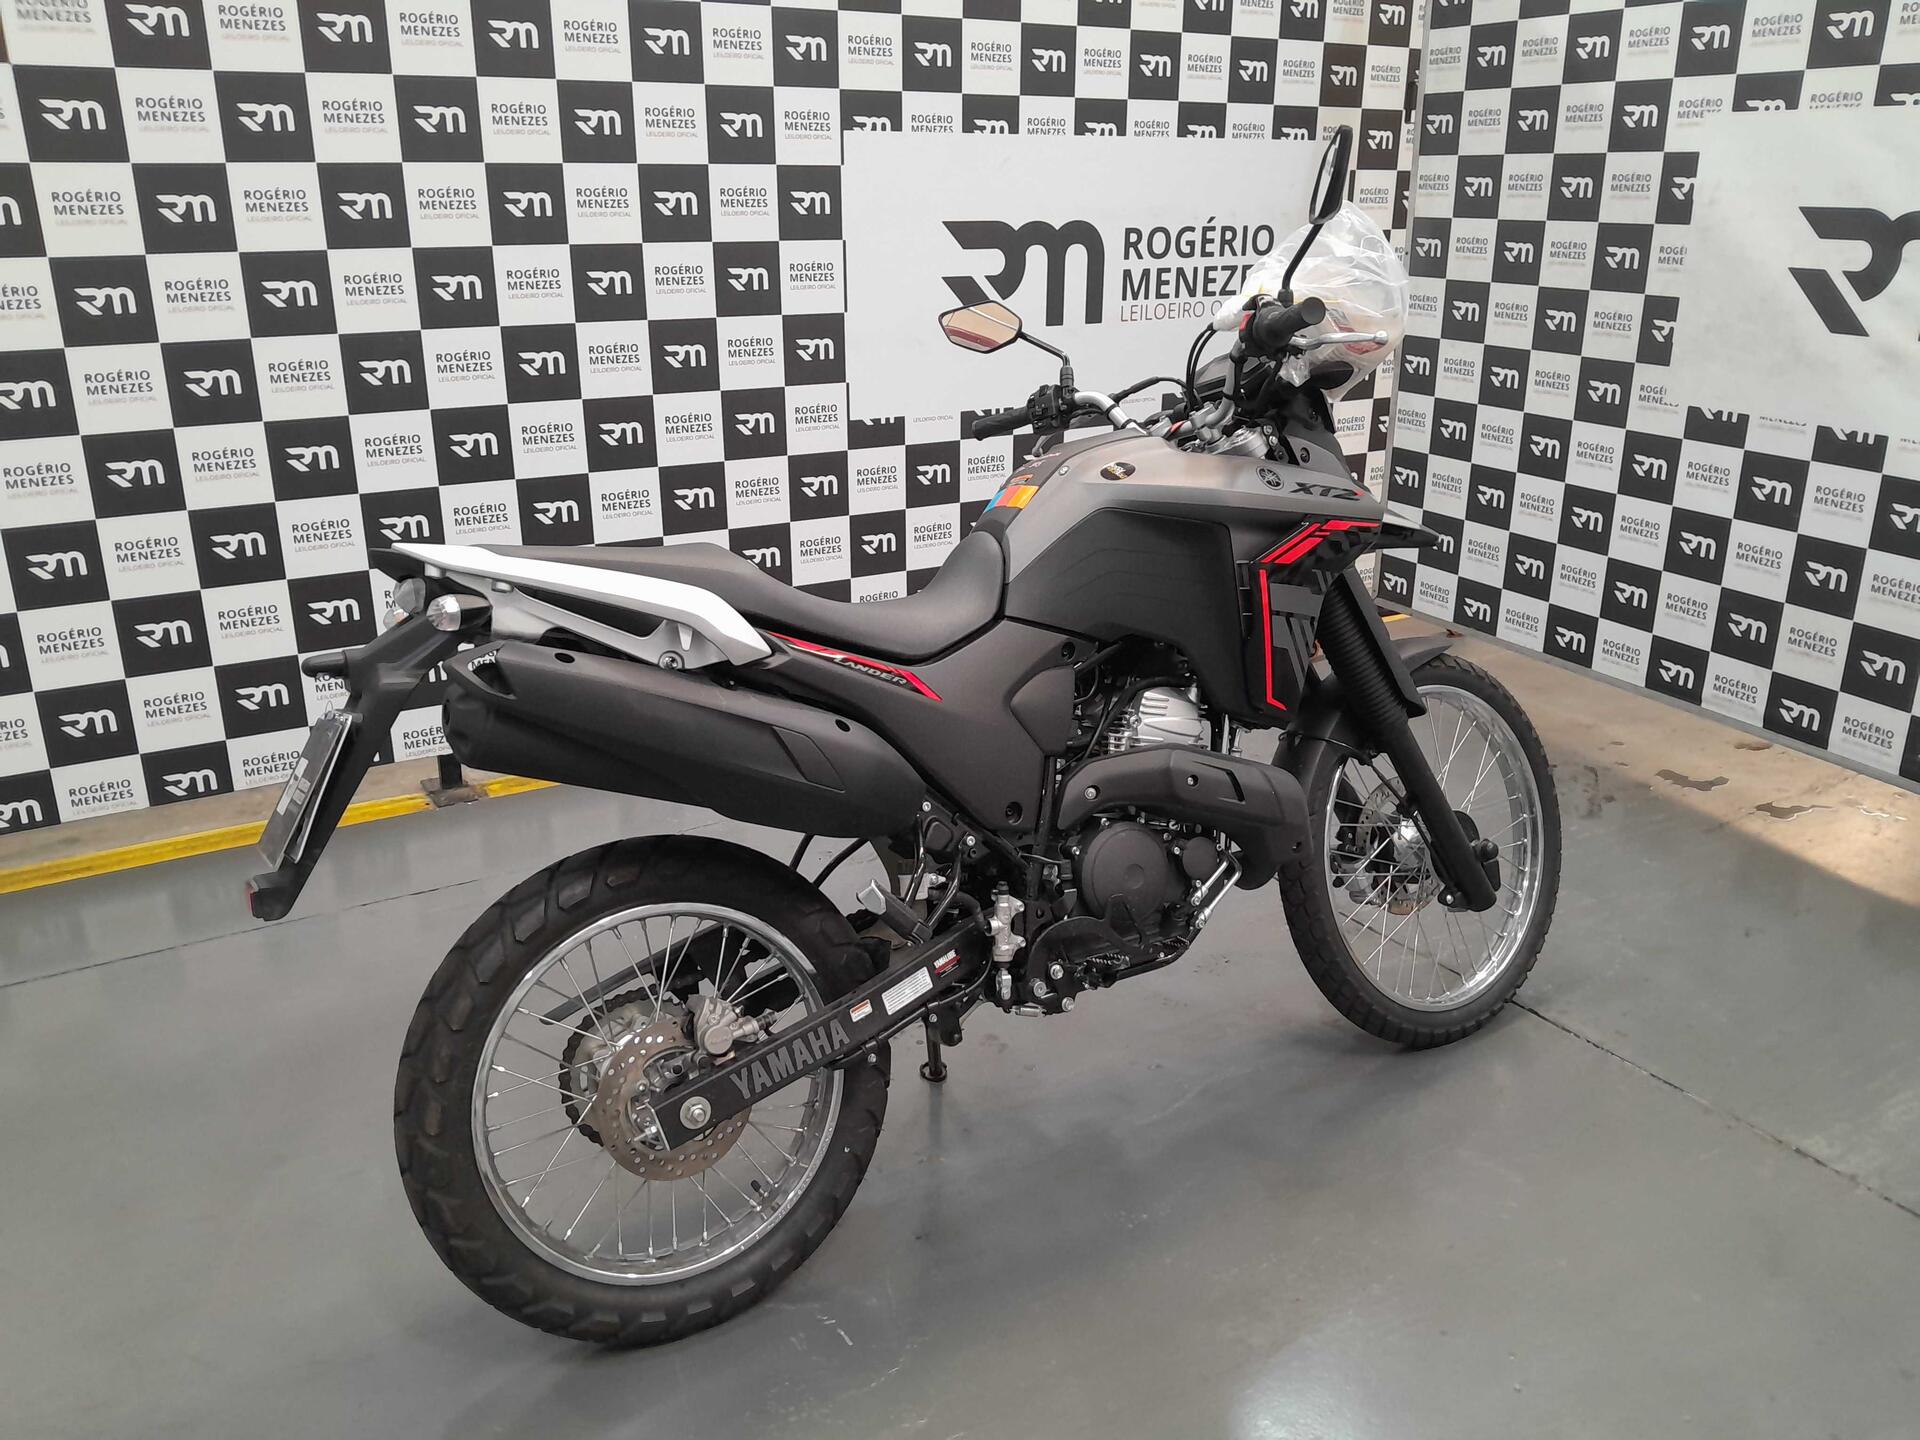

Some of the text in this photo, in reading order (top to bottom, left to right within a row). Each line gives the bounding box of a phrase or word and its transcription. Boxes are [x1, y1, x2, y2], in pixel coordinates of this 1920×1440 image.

[219, 4, 283, 17] ROGÉRIO
[220, 19, 285, 31] MENEZES
[564, 19, 616, 32] ROGÉRIO
[1752, 25, 1801, 37] MENEZES
[565, 32, 618, 44] MENEZES
[713, 27, 761, 39] ROGÉRIO
[714, 40, 761, 50] MENEZES
[848, 34, 892, 46] ROGÉRIO
[849, 47, 892, 56] MENEZES
[971, 41, 1011, 52] ROGÉRIO
[1522, 47, 1557, 56] MENEZES
[971, 53, 1011, 62] MENEZES
[1188, 54, 1222, 63] ROGÉRIO
[1188, 64, 1221, 72] MENEZES
[136, 96, 202, 109] ROGÉRIO
[492, 102, 546, 114] ROGÉRIO
[138, 111, 205, 122] MENEZES
[645, 105, 694, 117] ROGÉRIO
[785, 109, 829, 120] ROGÉRIO
[493, 116, 547, 126] MENEZES
[646, 119, 696, 128] MENEZES
[1566, 114, 1602, 122] MENEZES
[785, 122, 830, 131] MENEZES
[418, 186, 474, 198] ROGÉRIO
[576, 186, 627, 197] ROGÉRIO
[720, 186, 766, 197] ROGÉRIO
[1508, 183, 1542, 191] MENEZES
[52, 189, 120, 202] ROGÉRIO
[420, 200, 476, 210] MENEZES
[577, 199, 629, 208] MENEZES
[721, 199, 767, 207] MENEZES
[54, 205, 123, 215] MENEZES
[1123, 217, 1275, 260] ROGÉRIO
[1550, 251, 1586, 260] MENEZES
[655, 264, 703, 275] ROGÉRIO
[790, 261, 833, 272] ROGÉRIO
[507, 267, 559, 279] ROGÉRIO
[790, 273, 834, 282] MENEZES
[165, 278, 228, 290] ROGÉRIO
[508, 280, 561, 290] MENEZES
[656, 276, 704, 285] MENEZES
[1121, 265, 1253, 301] MENEZ
[167, 291, 231, 303] MENEZES
[1120, 304, 1205, 322] LEILOEIRO
[1593, 321, 1631, 331] MENEZES
[728, 336, 773, 347] ROGÉRIO
[589, 342, 638, 354] ROGÉRIO
[728, 348, 774, 357] MENEZES
[436, 350, 490, 362] ROGÉRIO
[590, 354, 639, 364] MENEZES
[437, 362, 492, 373] MENEZES
[85, 369, 150, 383] ROGÉRIO
[87, 382, 153, 395] MENEZES
[1535, 379, 1569, 391] MENEZES
[795, 403, 837, 414] ROGÉRIO
[665, 412, 711, 424] ROGÉRIO
[796, 414, 838, 424] MENEZES
[522, 422, 572, 435] ROGÉRIO
[666, 423, 712, 434] MENEZES
[365, 433, 420, 447] ROGÉRIO
[523, 433, 574, 445] MENEZES
[366, 445, 422, 457] MENEZES
[968, 455, 1004, 465] ROGÉRIO
[3, 463, 70, 477] ROGÉRIO
[857, 465, 896, 476] ROGÉRIO
[968, 464, 1005, 473] MENEZES
[6, 475, 73, 489] MENEZES
[857, 475, 897, 485] MENEZES
[1686, 471, 1729, 486] MENEZES
[601, 489, 649, 502] ROGÉRIO
[1289, 482, 1360, 501] XTZ
[454, 503, 506, 516] ROGÉRIO
[602, 499, 650, 511] MENEZES
[455, 513, 508, 526] MENEZES
[914, 522, 951, 534] ROGÉRIO
[1620, 524, 1659, 540] MENEZES
[800, 536, 840, 548] ROGÉRIO
[914, 531, 952, 542] MENEZES
[115, 537, 177, 551] ROGÉRIO
[117, 548, 180, 562] MENEZES
[801, 545, 841, 556] MENEZES
[1736, 552, 1781, 569] MENEZES
[218, 605, 277, 620] ROGÉRIO
[1666, 602, 1706, 620] MENEZES
[220, 615, 280, 630] MENEZES
[37, 627, 101, 643] ROGÉRIO
[39, 638, 104, 654] MENEZES
[834, 657, 907, 684] LANDER
[144, 692, 204, 708] ROGÉRIO
[146, 702, 207, 718] MENEZES
[1842, 726, 1892, 749] MENEZES
[69, 780, 130, 797] ROGÉRIO
[71, 789, 133, 807] MENEZES
[730, 1020, 850, 1099] YAMAHA
